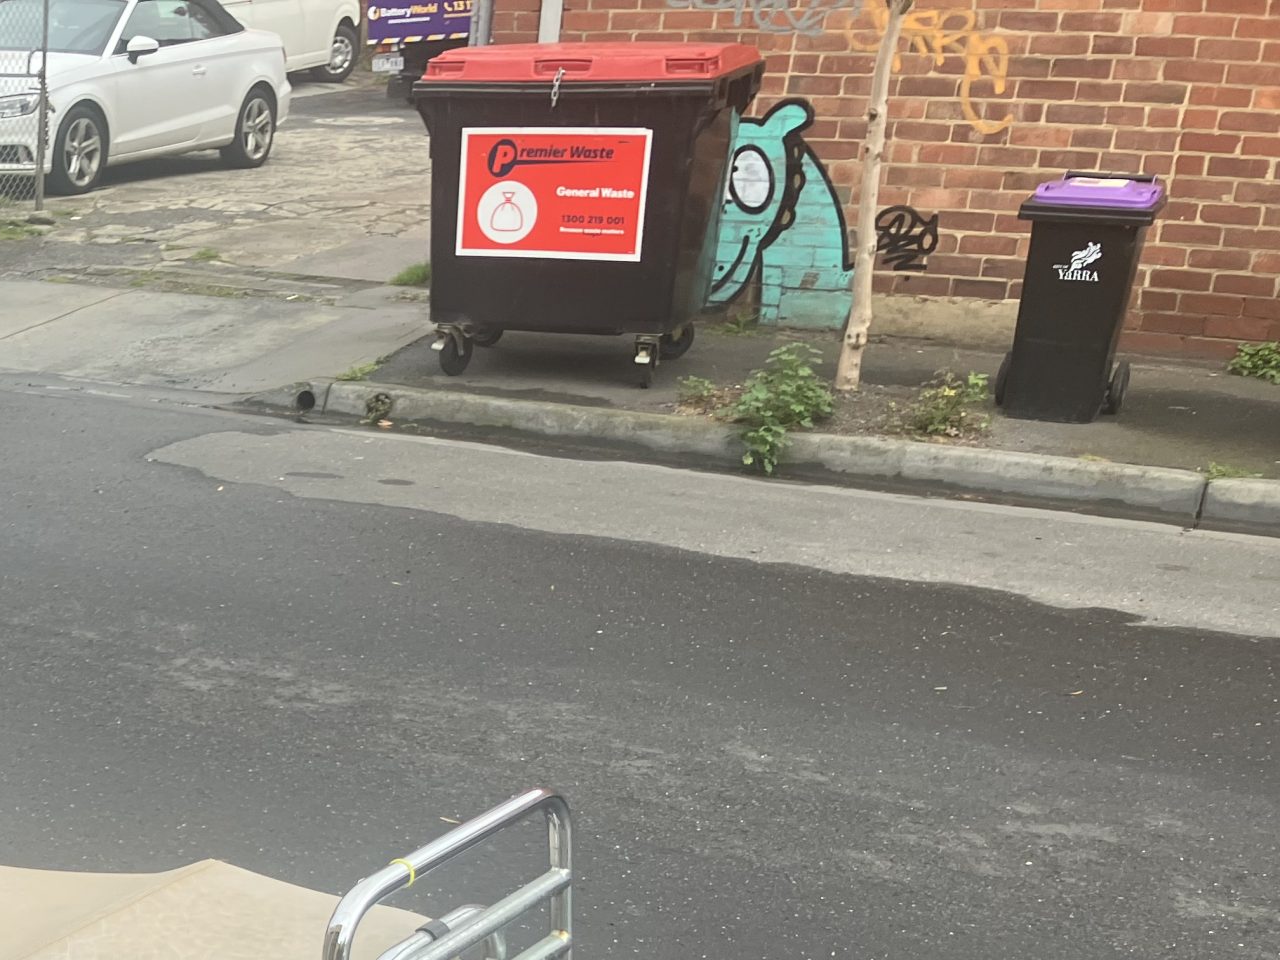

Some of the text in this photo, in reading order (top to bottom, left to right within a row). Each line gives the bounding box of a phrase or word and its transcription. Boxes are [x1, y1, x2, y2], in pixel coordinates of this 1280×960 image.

[488, 139, 614, 177] Premier Waste
[556, 186, 634, 198] General Waste
[562, 215, 584, 223] 1300
